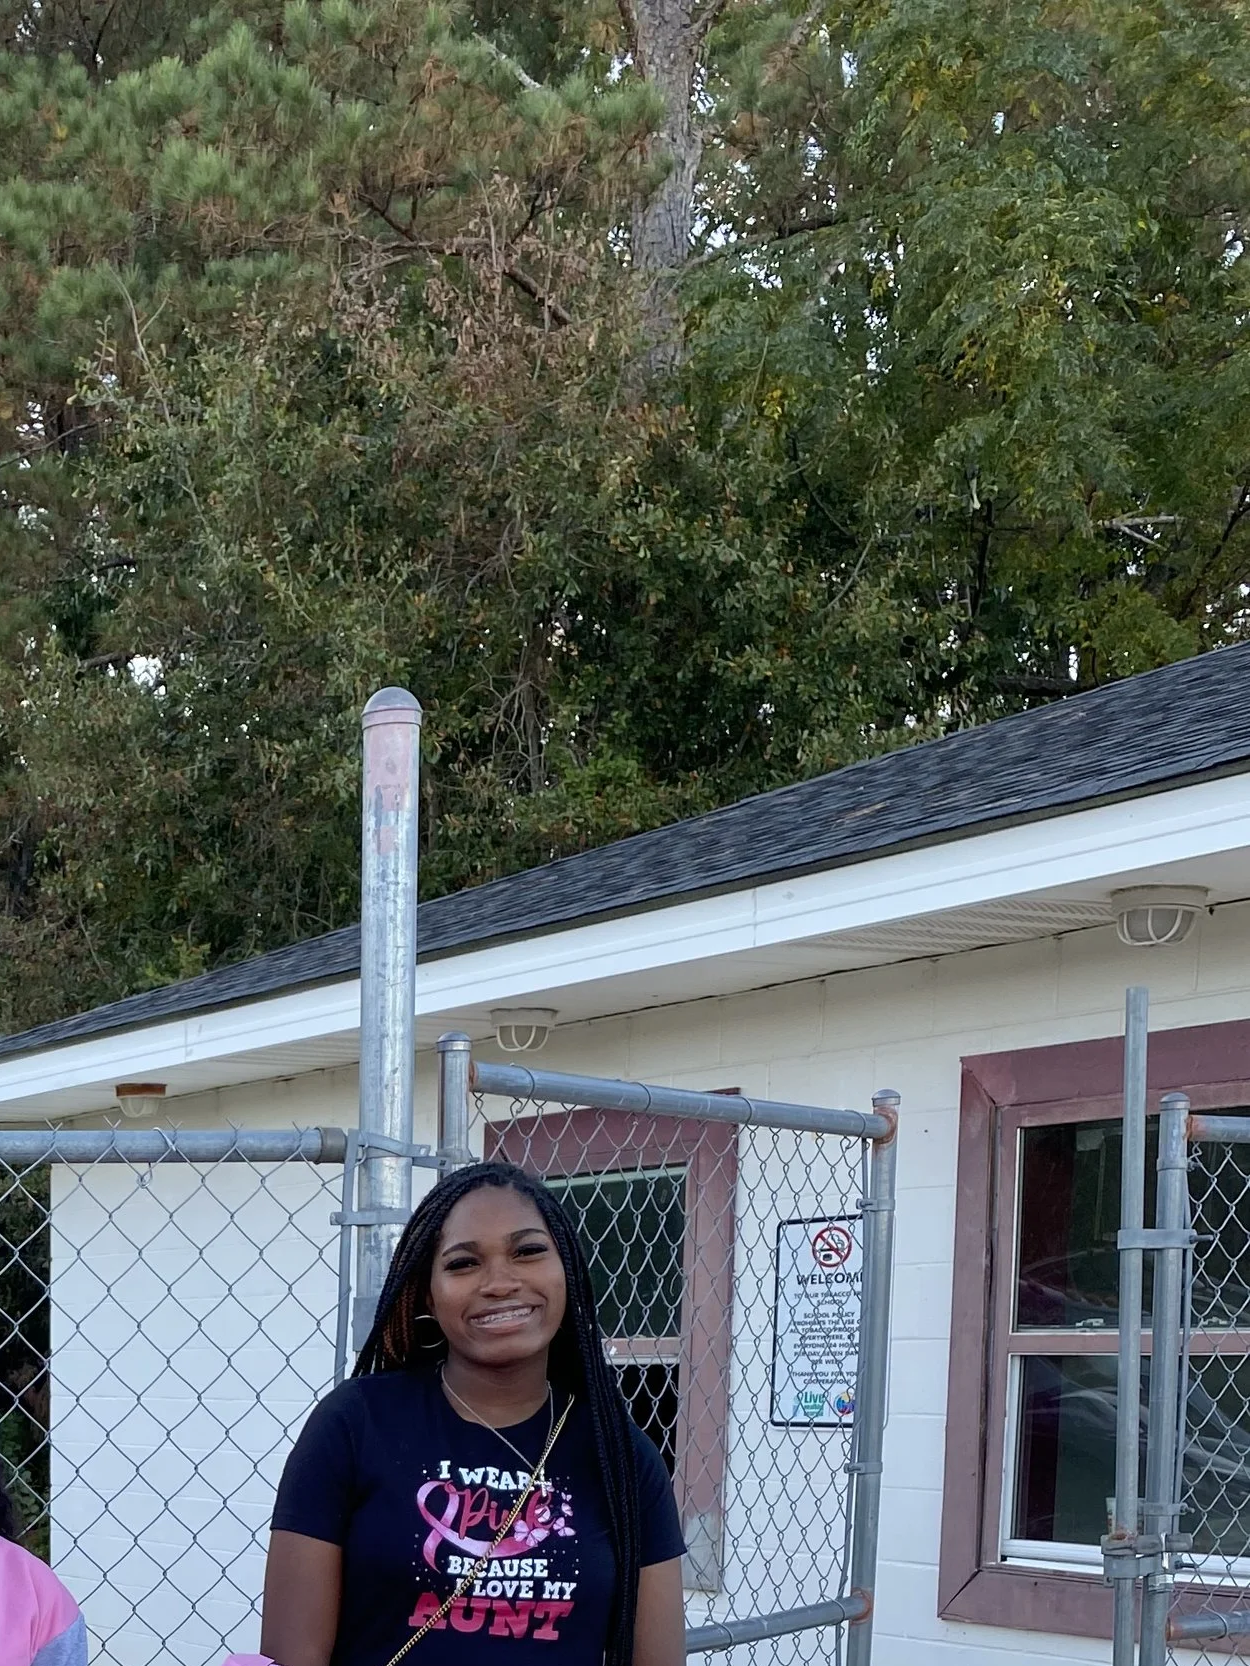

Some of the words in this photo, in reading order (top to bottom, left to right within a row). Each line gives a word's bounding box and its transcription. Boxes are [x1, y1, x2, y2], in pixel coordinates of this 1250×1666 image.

[796, 1271, 863, 1286] WELCOM
[439, 1460, 451, 1480] I
[458, 1466, 535, 1492] WEAR
[447, 1555, 549, 1578] BECAUSE
[472, 1579, 534, 1599] LOVE
[542, 1581, 577, 1601] MY
[408, 1592, 576, 1641] AUNT
